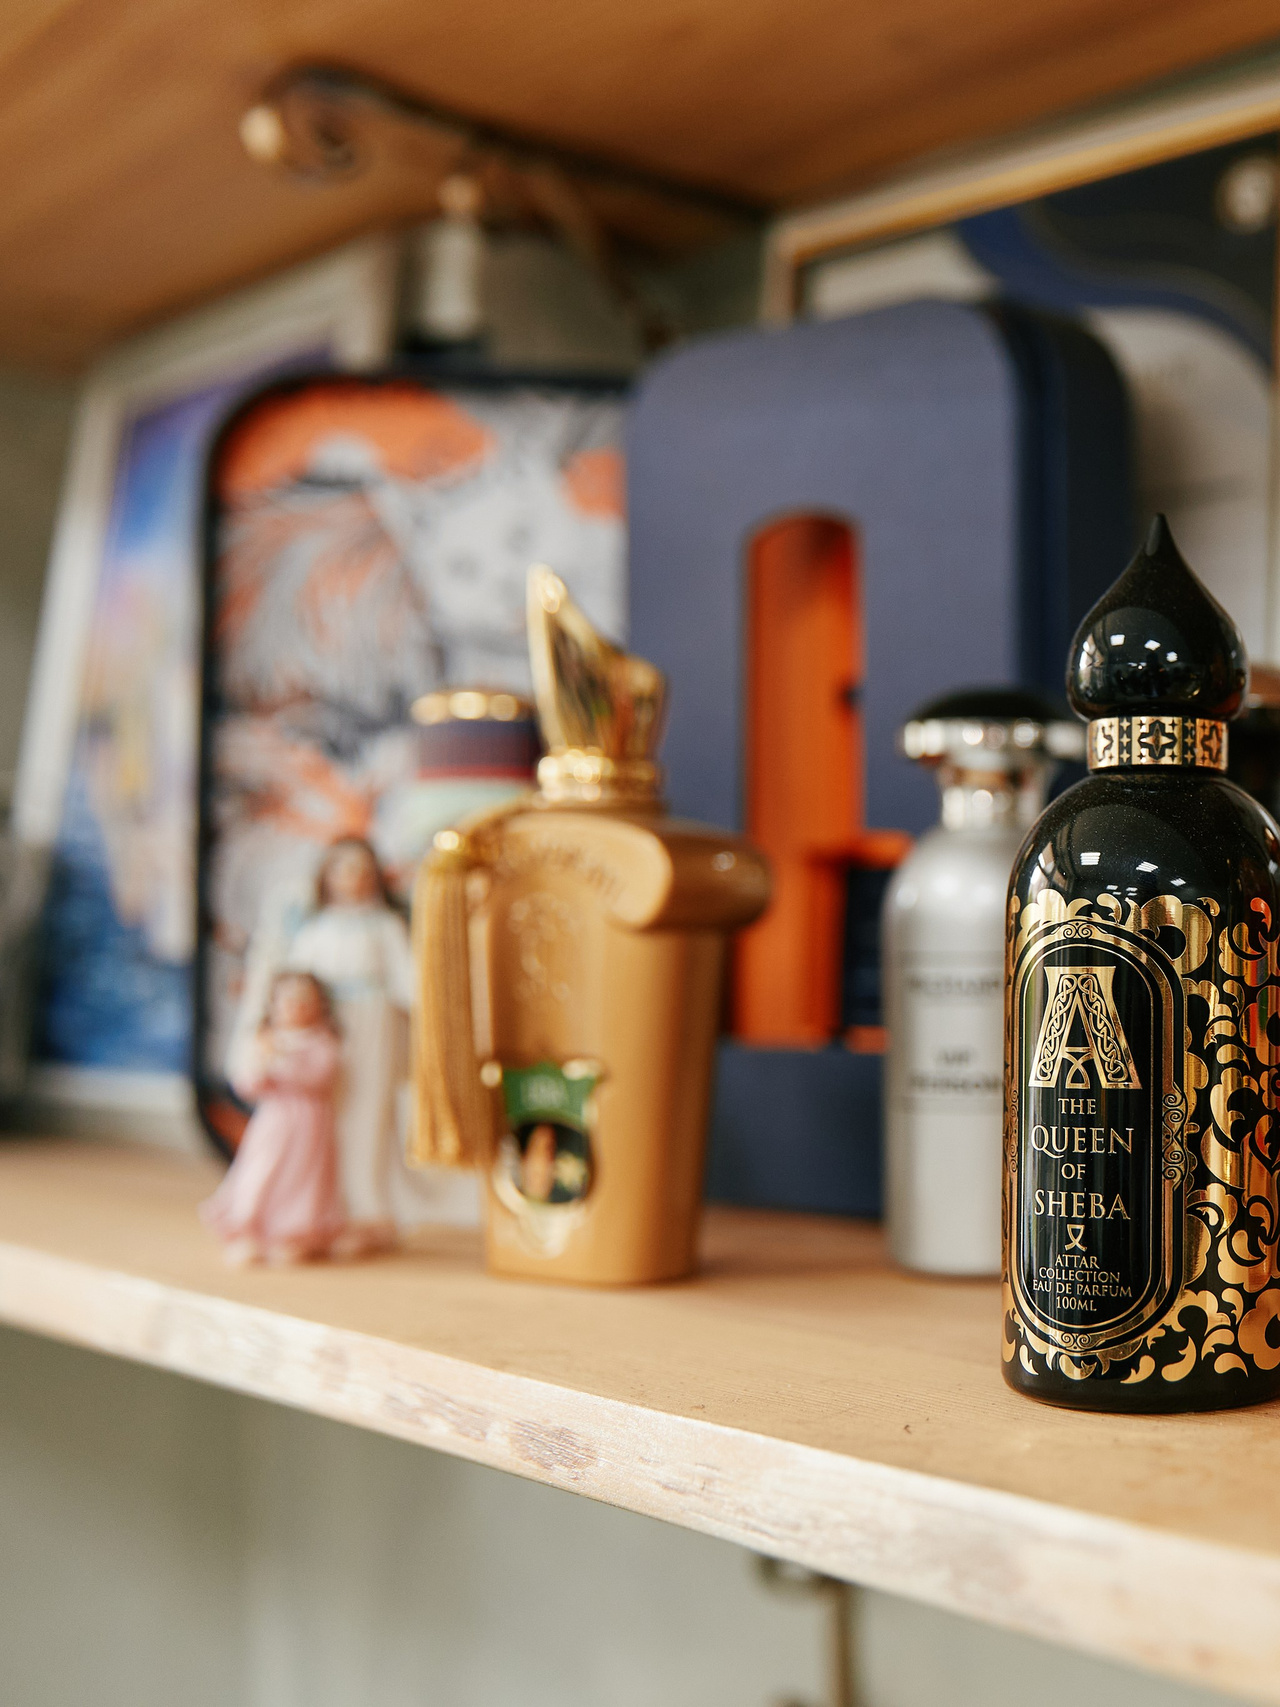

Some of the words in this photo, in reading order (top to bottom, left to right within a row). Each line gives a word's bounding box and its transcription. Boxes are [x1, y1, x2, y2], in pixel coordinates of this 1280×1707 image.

[1057, 1097, 1097, 1115] THE
[1031, 1124, 1135, 1159] QUEEN
[1061, 1162, 1086, 1180] OF
[1034, 1188, 1131, 1220] SHEBA
[1054, 1253, 1100, 1270] ATTAR
[1038, 1266, 1121, 1284] COLLECTION
[1032, 1279, 1052, 1293] EAU
[1056, 1281, 1072, 1295] DE
[1076, 1282, 1133, 1298] PARFUM
[1055, 1295, 1098, 1312] 100ML
